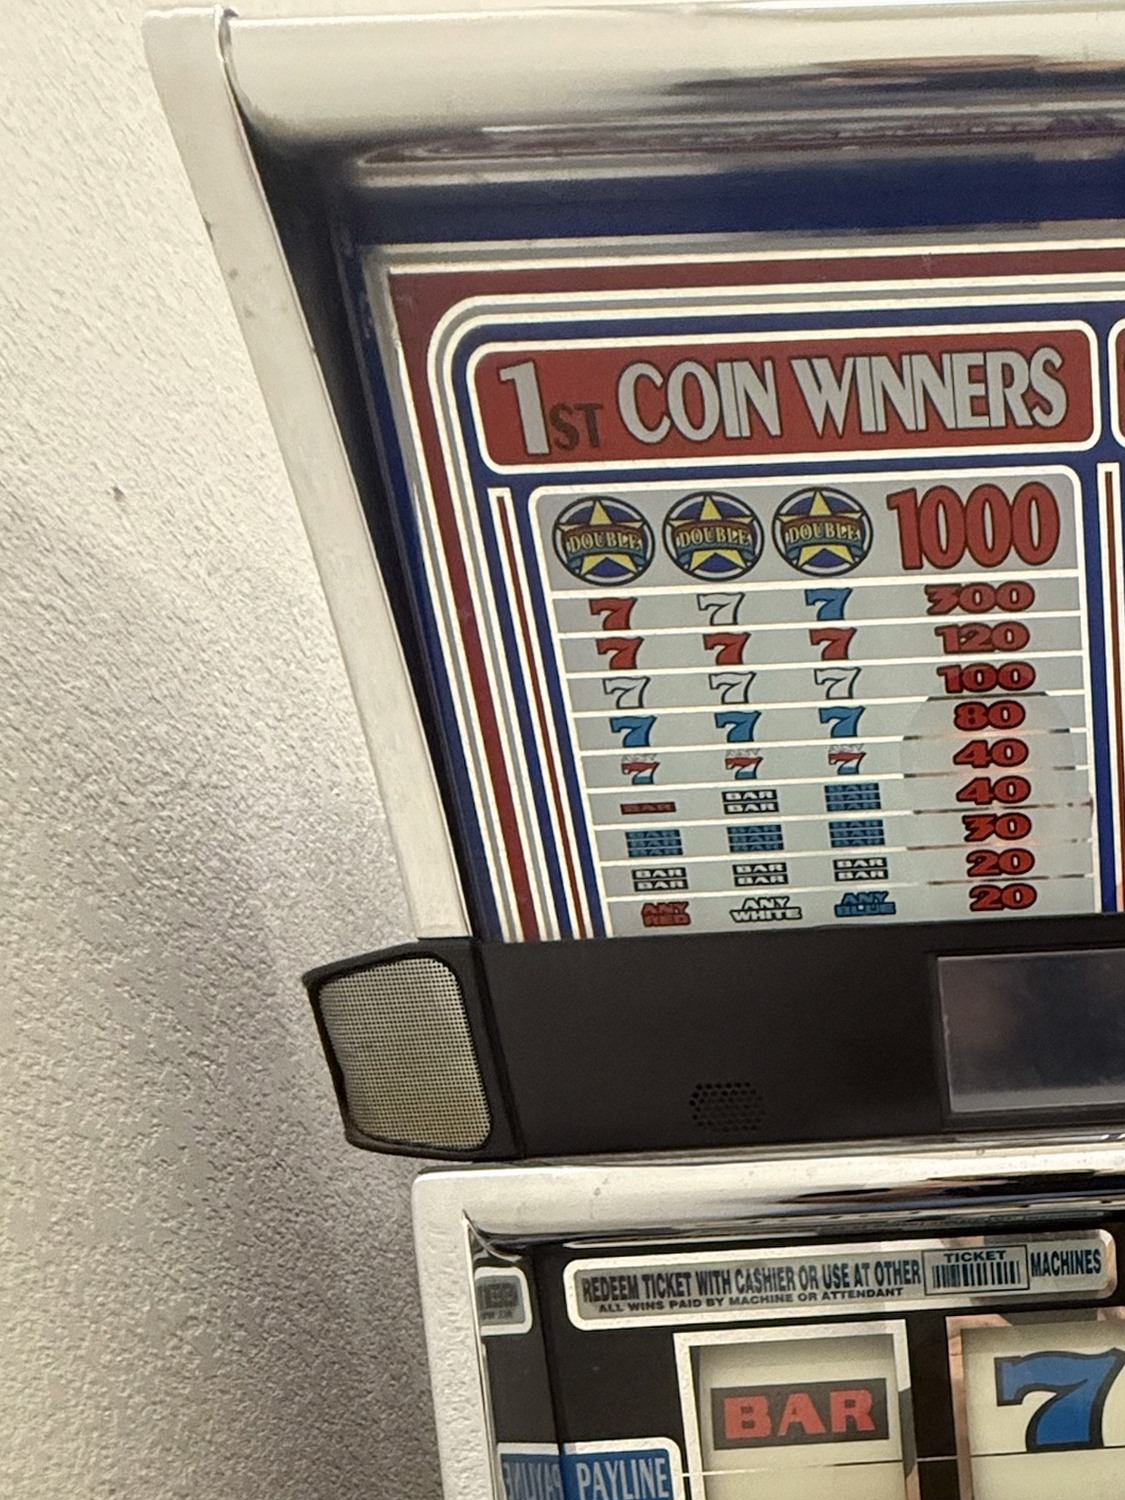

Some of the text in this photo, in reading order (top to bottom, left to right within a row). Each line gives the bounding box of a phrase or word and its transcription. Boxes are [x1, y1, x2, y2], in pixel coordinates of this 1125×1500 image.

[500, 348, 1066, 455] 1ST COIN WINNERS
[677, 527, 750, 548] DOUBLE
[787, 523, 861, 543] DOUBLE
[888, 482, 1059, 569] 1000
[568, 532, 641, 552] DOUBLE
[589, 581, 1034, 630] 7 7 7 300
[934, 621, 1030, 654] 120
[937, 661, 1036, 693] 100
[954, 700, 1025, 731] 80
[954, 738, 1028, 768] 40
[956, 776, 1030, 805] 40
[962, 812, 1031, 842] 30
[967, 848, 1034, 877] 20
[742, 896, 790, 909] ANY
[970, 883, 1037, 911] 20
[730, 907, 802, 922] WHITE
[582, 1249, 1101, 1303] REDEEM TICKET WITH CASHIER OR USE AT OTHER TICKET MACHINES
[599, 1287, 904, 1313] ALL WINS PAID BY MACHINE OR ATTENDANT
[724, 1389, 876, 1440] BAR
